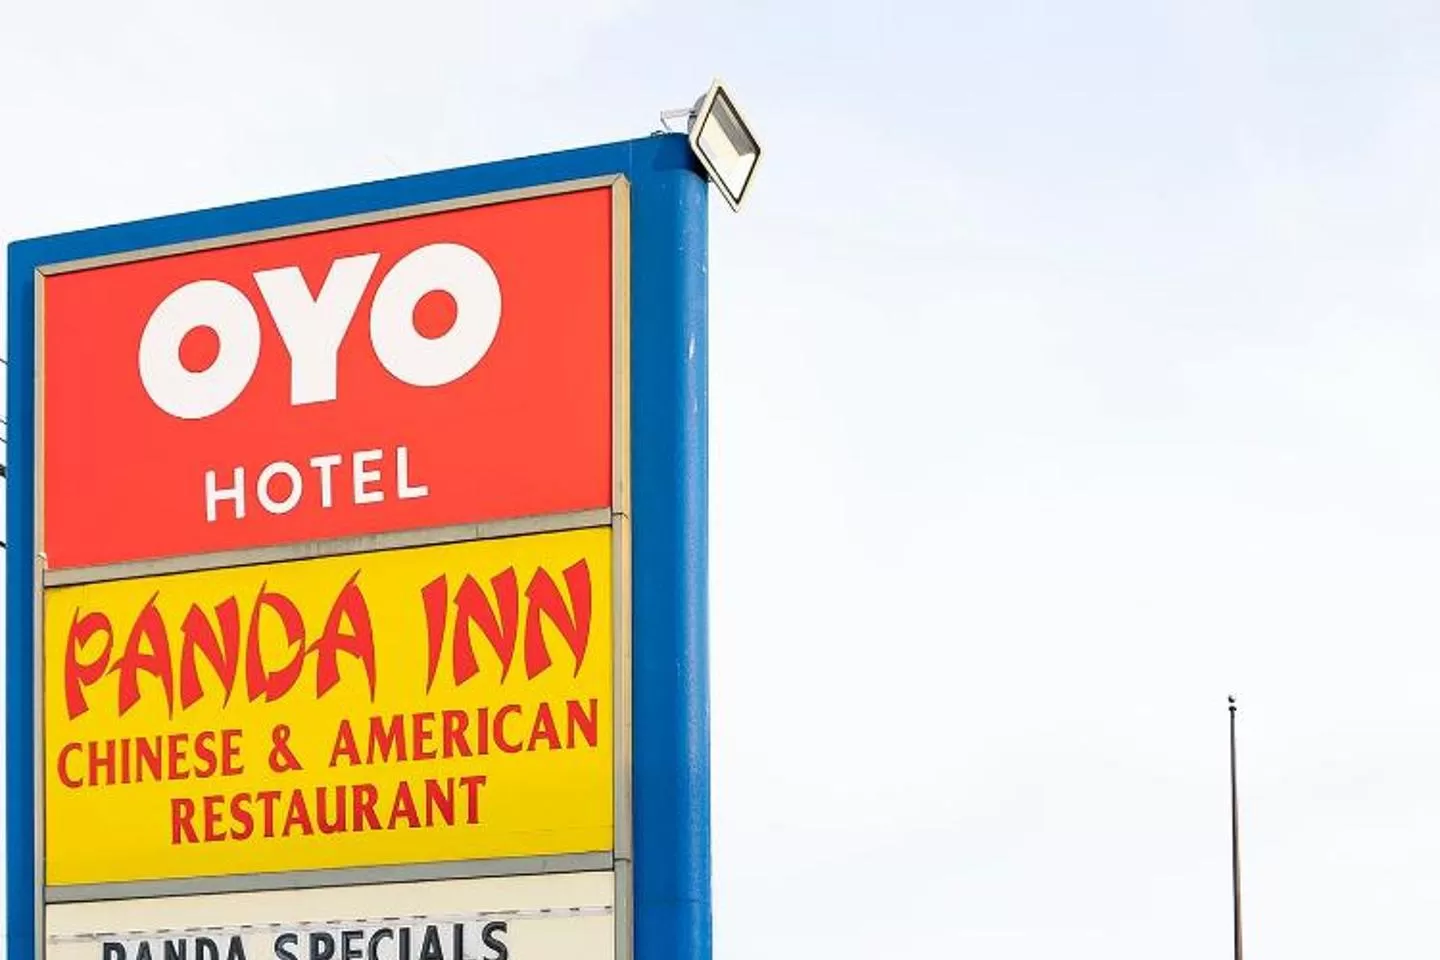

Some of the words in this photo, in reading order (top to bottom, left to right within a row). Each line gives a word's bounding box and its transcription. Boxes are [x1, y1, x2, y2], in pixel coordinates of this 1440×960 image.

[138, 241, 503, 420] OYO
[204, 445, 429, 523] HOTEL
[63, 569, 378, 721] PANDA
[421, 557, 593, 694] INN
[56, 728, 244, 789] CHINESE
[268, 722, 303, 773] &
[328, 697, 599, 770] AMERICAN
[169, 774, 488, 846] RESTAURANT
